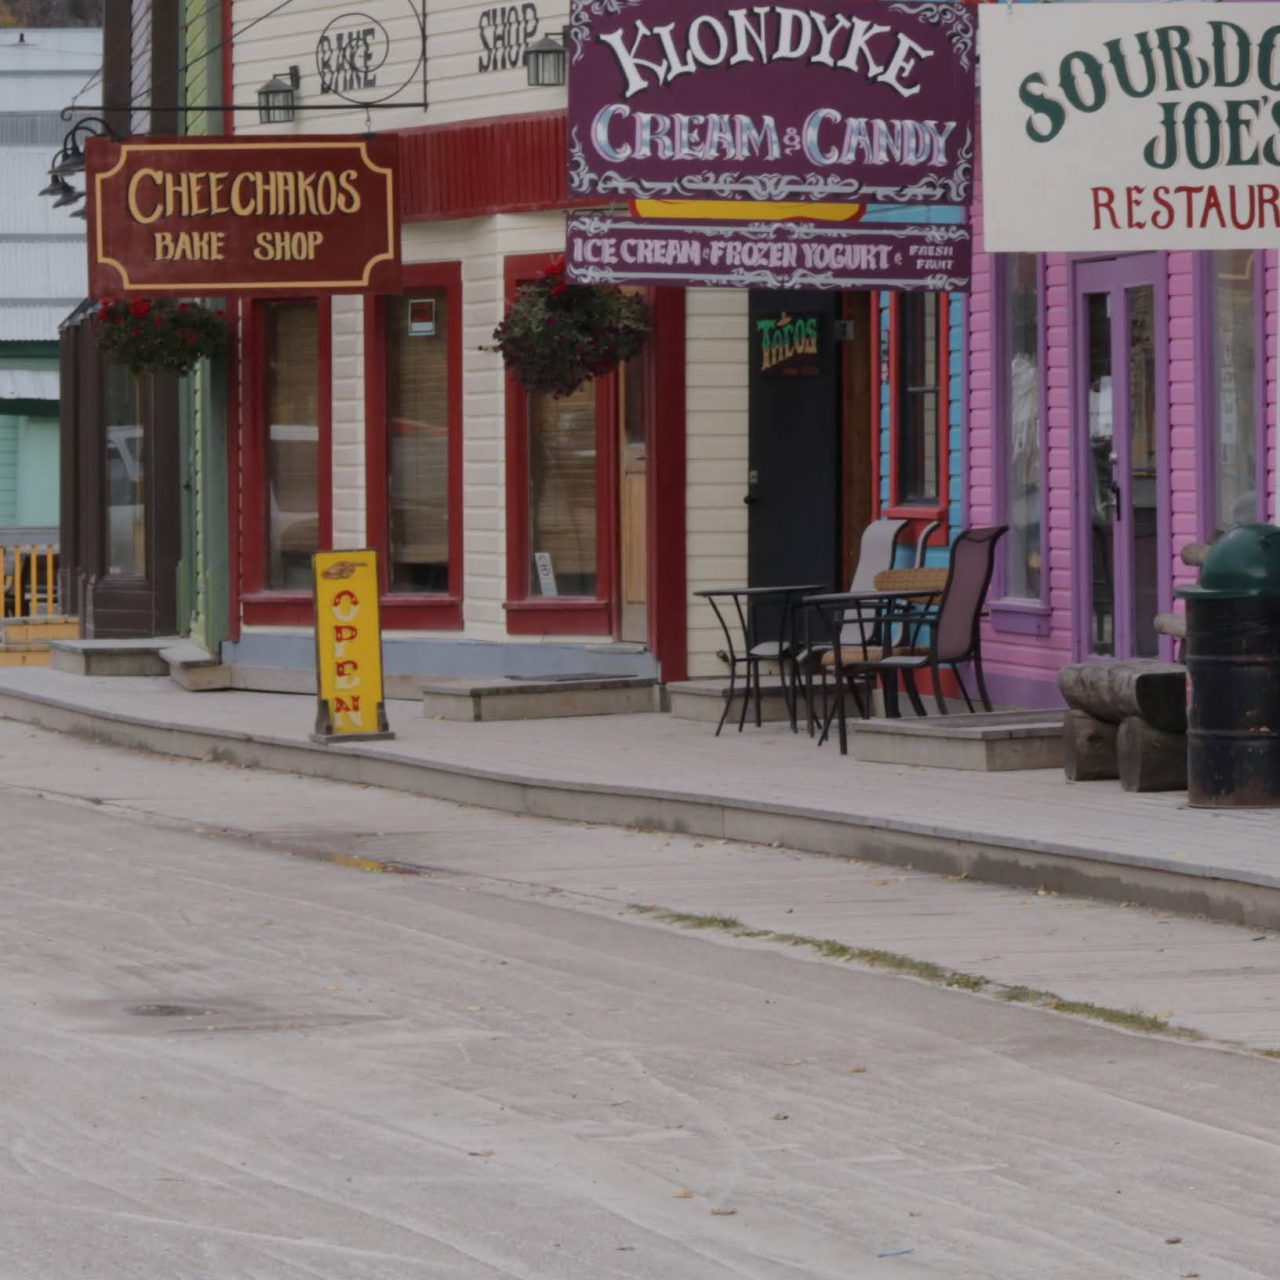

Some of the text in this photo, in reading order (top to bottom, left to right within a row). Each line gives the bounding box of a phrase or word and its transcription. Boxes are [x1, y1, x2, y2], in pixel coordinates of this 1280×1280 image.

[319, 27, 377, 95] BAKE
[478, 2, 540, 74] SHOP
[600, 6, 934, 98] KLONDYKE
[591, 103, 782, 163] CREAM
[802, 107, 957, 167] CANDY
[127, 167, 362, 223] CHEECHAKOS
[155, 230, 324, 262] BAKE SHOP
[573, 237, 894, 270] ICE CREAM FROZEN YOGURT
[909, 244, 954, 257] FRESH
[916, 258, 955, 270] FRUIT
[331, 589, 364, 728] OPEN
